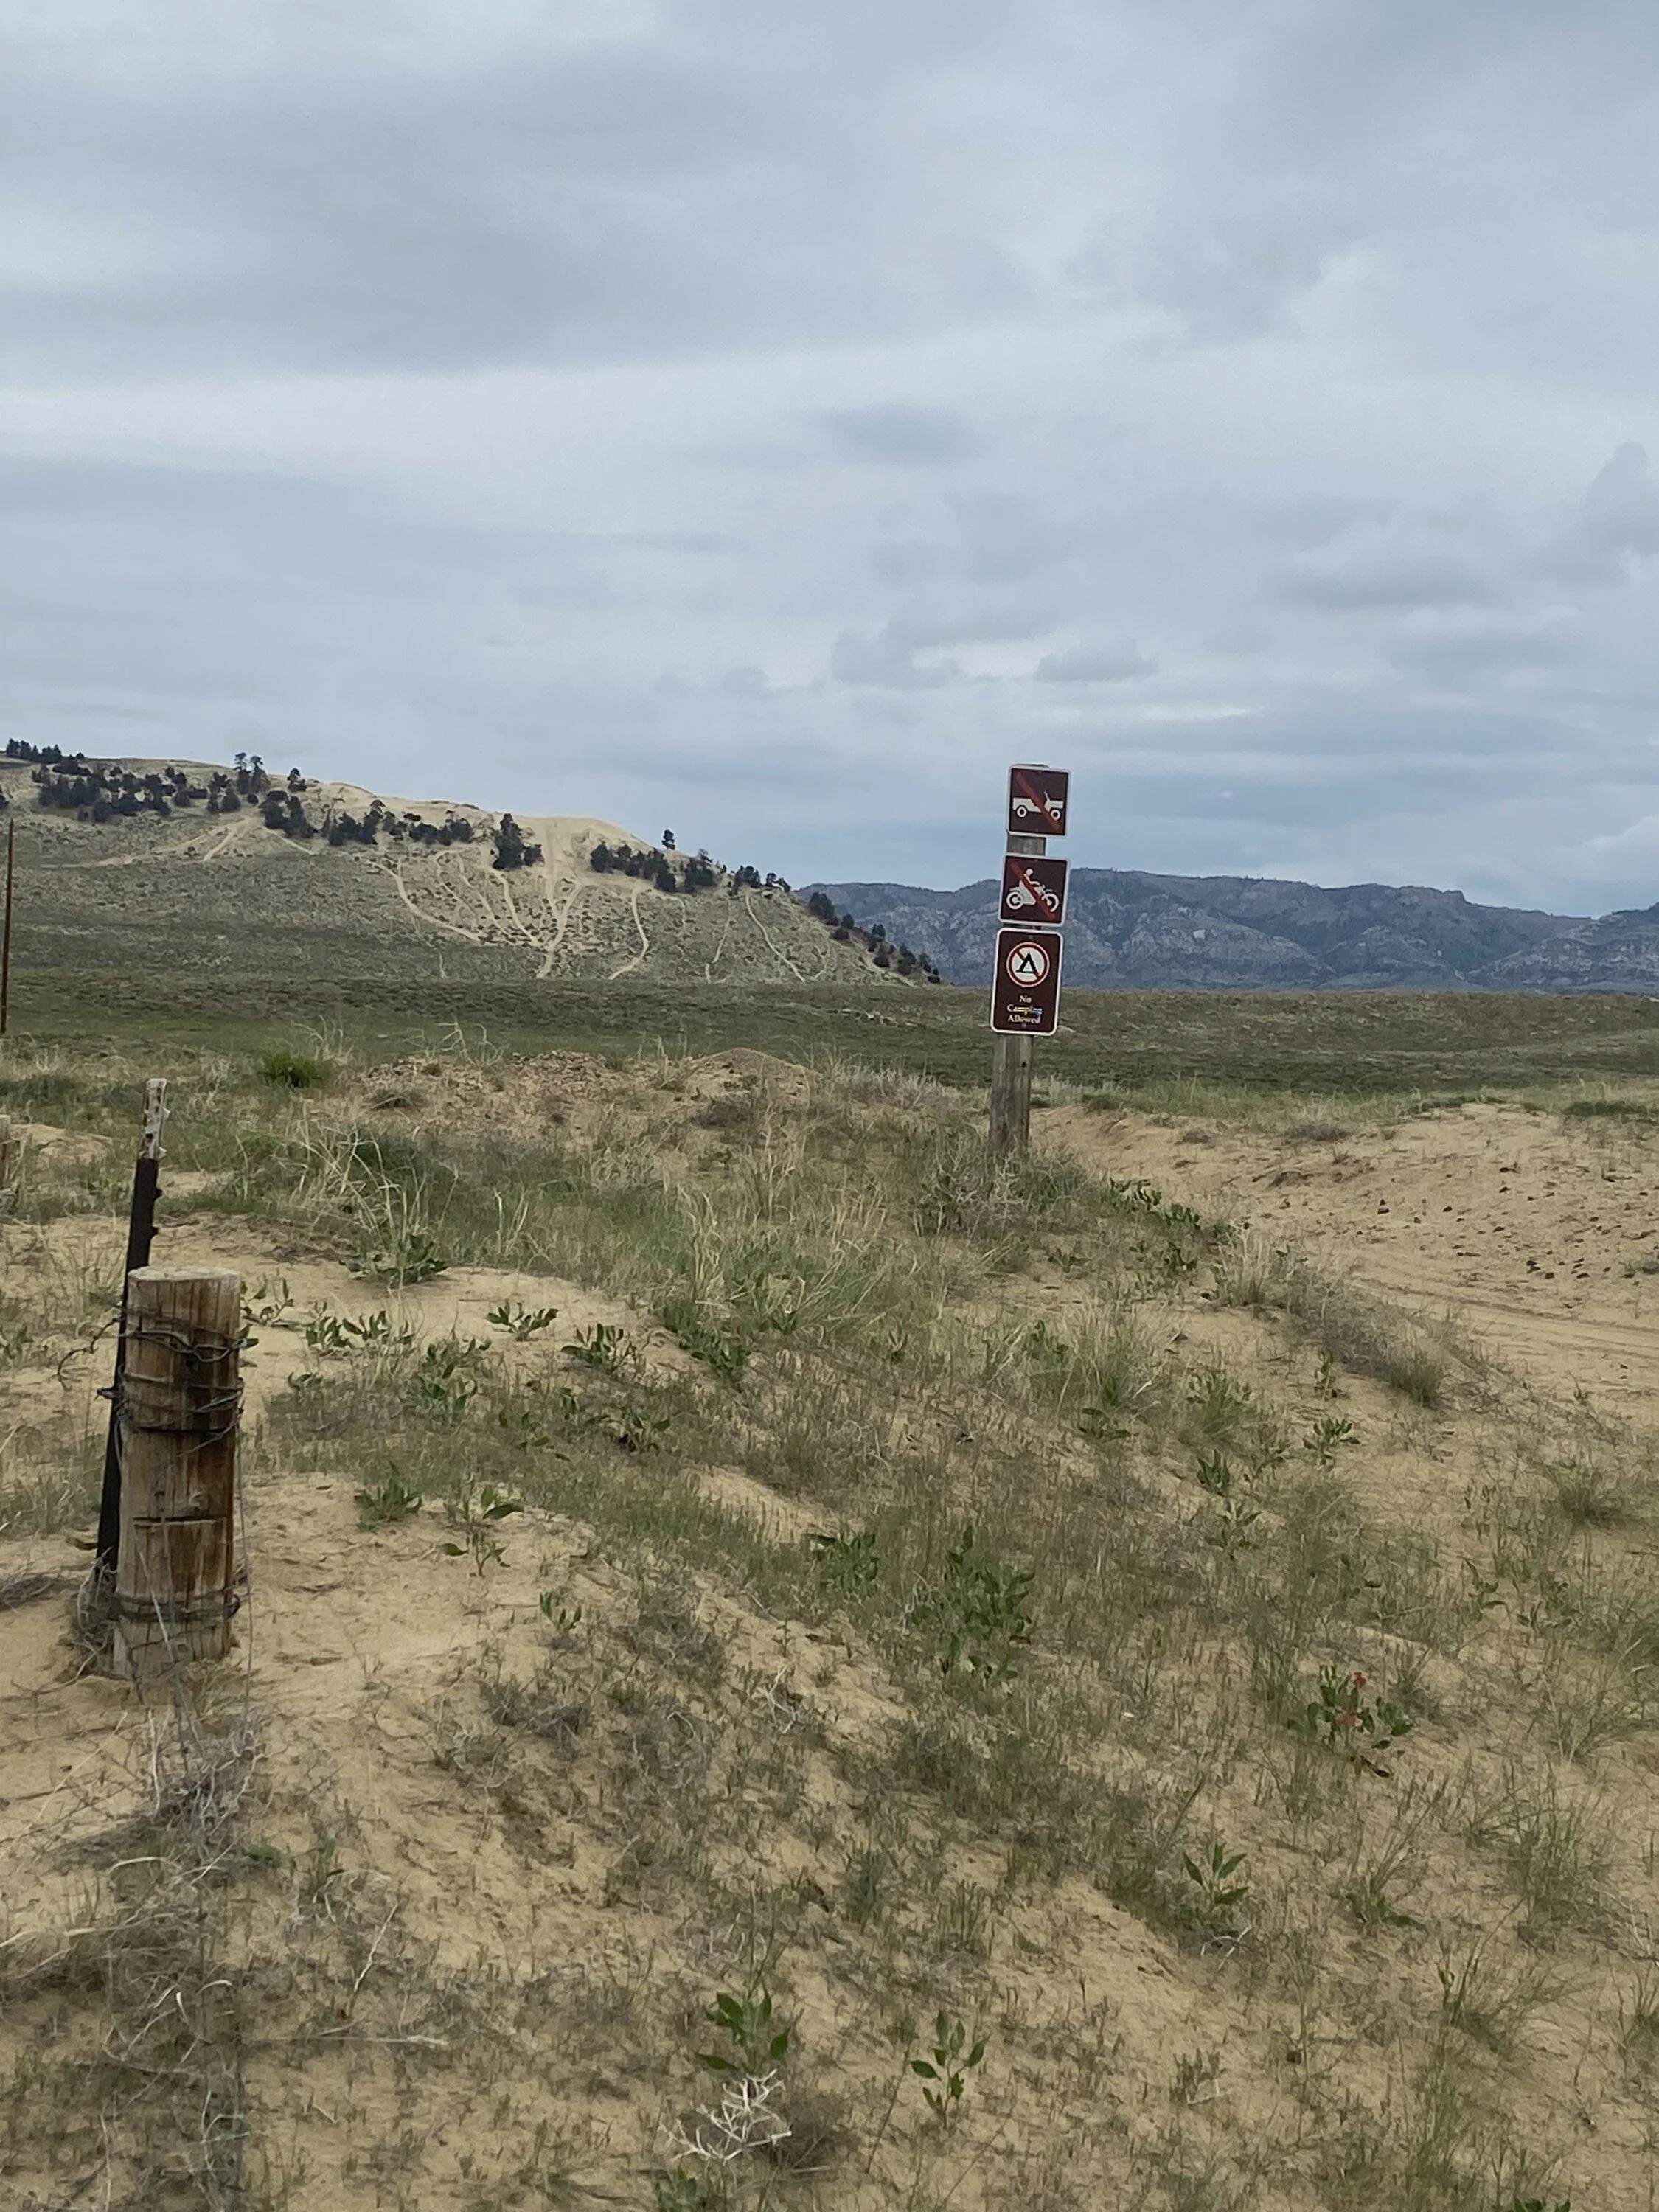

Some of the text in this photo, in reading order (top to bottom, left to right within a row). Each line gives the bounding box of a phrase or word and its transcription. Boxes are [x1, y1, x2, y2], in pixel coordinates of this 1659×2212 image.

[1019, 995, 1032, 1003] No
[1007, 1004, 1043, 1015] Camping
[1007, 1014, 1041, 1023] Allowed
